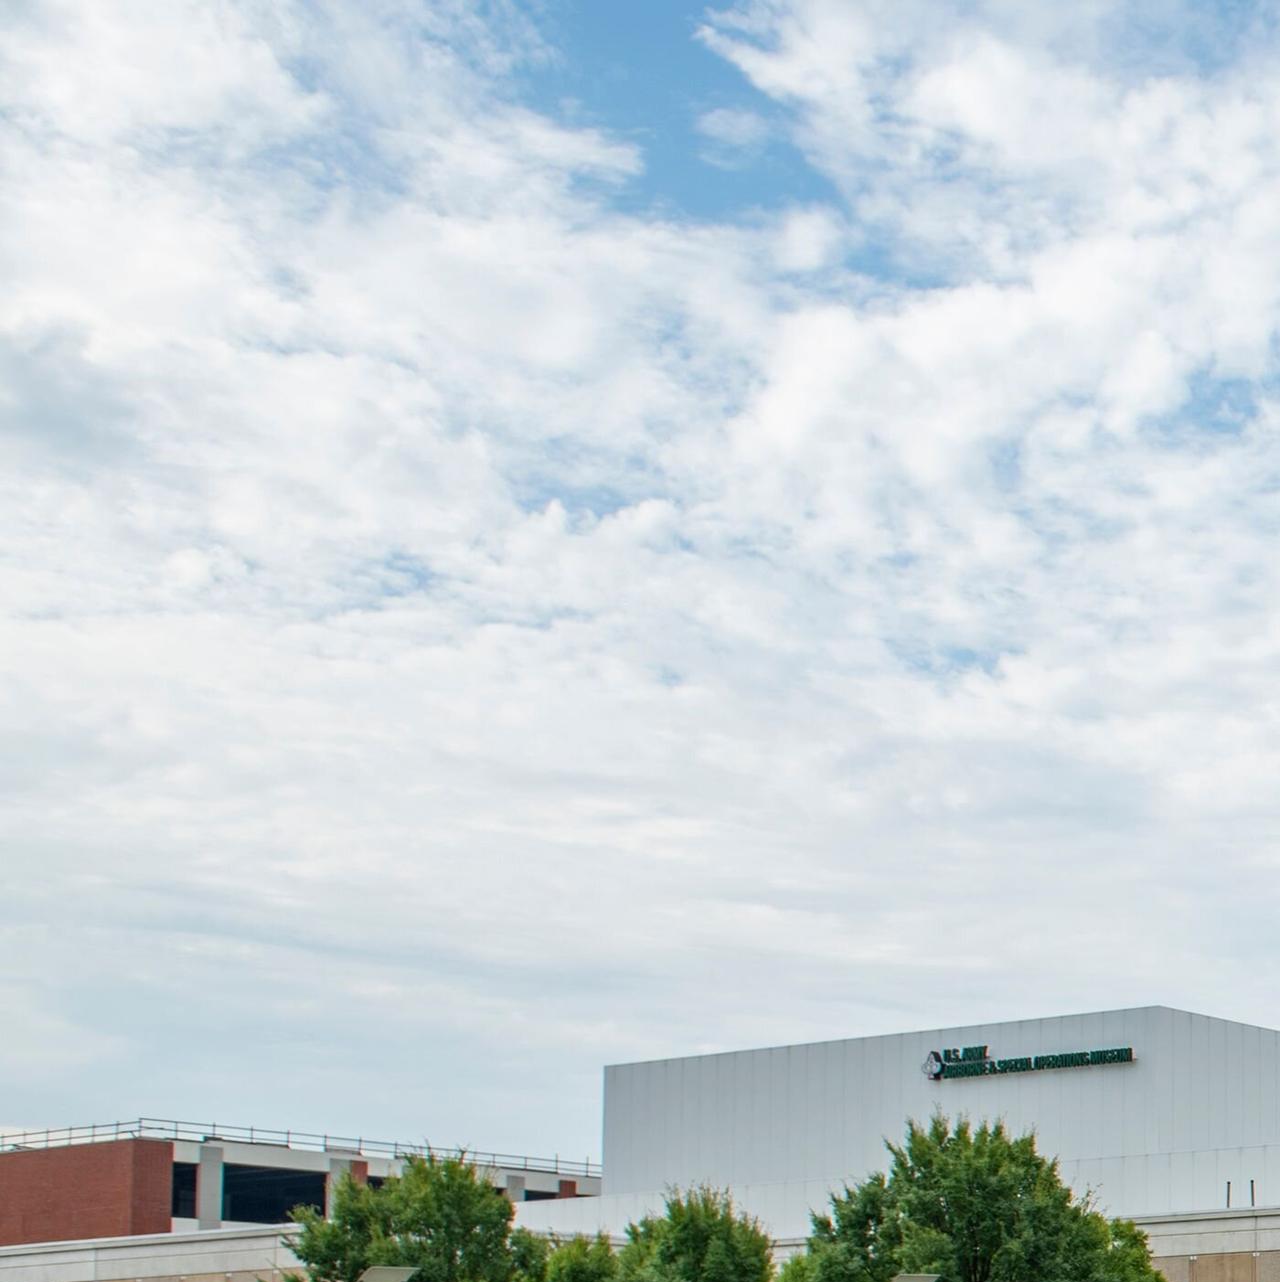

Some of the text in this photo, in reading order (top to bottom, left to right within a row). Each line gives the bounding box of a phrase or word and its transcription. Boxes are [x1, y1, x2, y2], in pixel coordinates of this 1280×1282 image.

[943, 1045, 988, 1062] U.S. ARMY
[997, 1057, 1033, 1074] SPECIAL
[1033, 1051, 1089, 1070] OPERATIONS
[1089, 1047, 1132, 1065] MUSEUM
